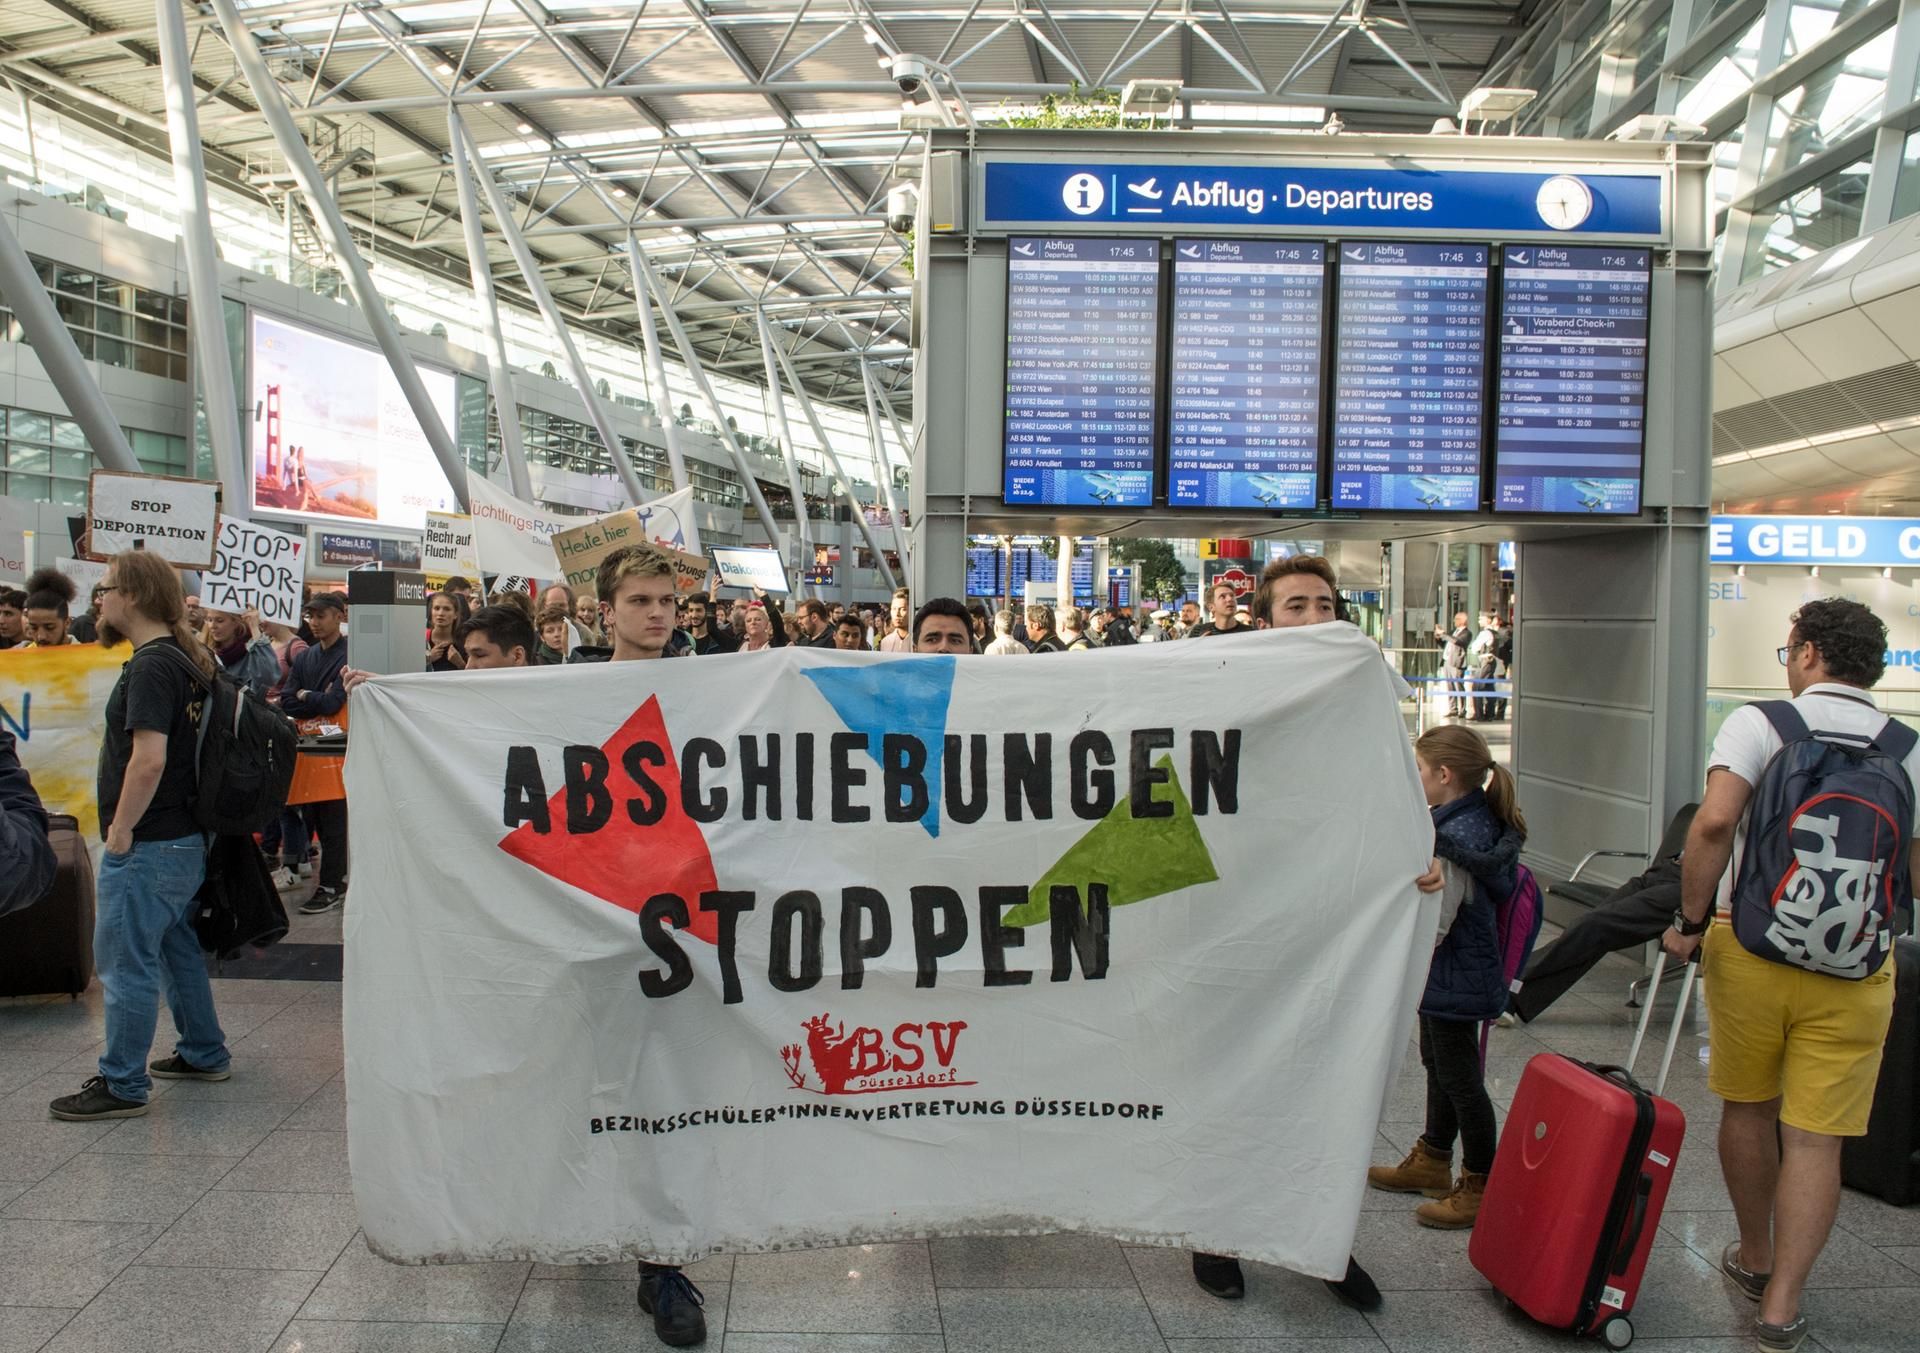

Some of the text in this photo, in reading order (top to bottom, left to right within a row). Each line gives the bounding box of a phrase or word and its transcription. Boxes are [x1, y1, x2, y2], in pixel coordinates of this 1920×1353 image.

[1171, 182, 1433, 216] Abflug Departures
[1044, 241, 1153, 257] Abflug 17:45 1
[1211, 243, 1319, 260] Abflug 17:45 2
[1375, 246, 1483, 263] Abflug 17:45 3
[1538, 250, 1644, 267] Abflug 17:45 4
[1533, 318, 1615, 328] Vorabend Check-in
[1037, 398, 1064, 406] Budapest
[1036, 423, 1072, 431] London-LHR
[131, 500, 172, 514] STOP
[93, 519, 207, 541] DEPORTATION
[427, 519, 449, 529] Für das
[336, 537, 353, 548] Gates
[427, 529, 471, 547] Recht auf
[559, 525, 632, 558] Heute hier
[1748, 524, 1867, 557] GELD
[425, 544, 457, 559] Flucht!
[397, 580, 424, 599] Internet
[206, 582, 294, 620] TATION
[503, 728, 1243, 834] ABSCHIEBUNGEN
[637, 883, 1111, 1004] STOPPEN
[856, 1021, 968, 1074] BSV
[858, 1068, 958, 1088] Düsseldorf
[1014, 1097, 1165, 1121] DÜSSELDORF
